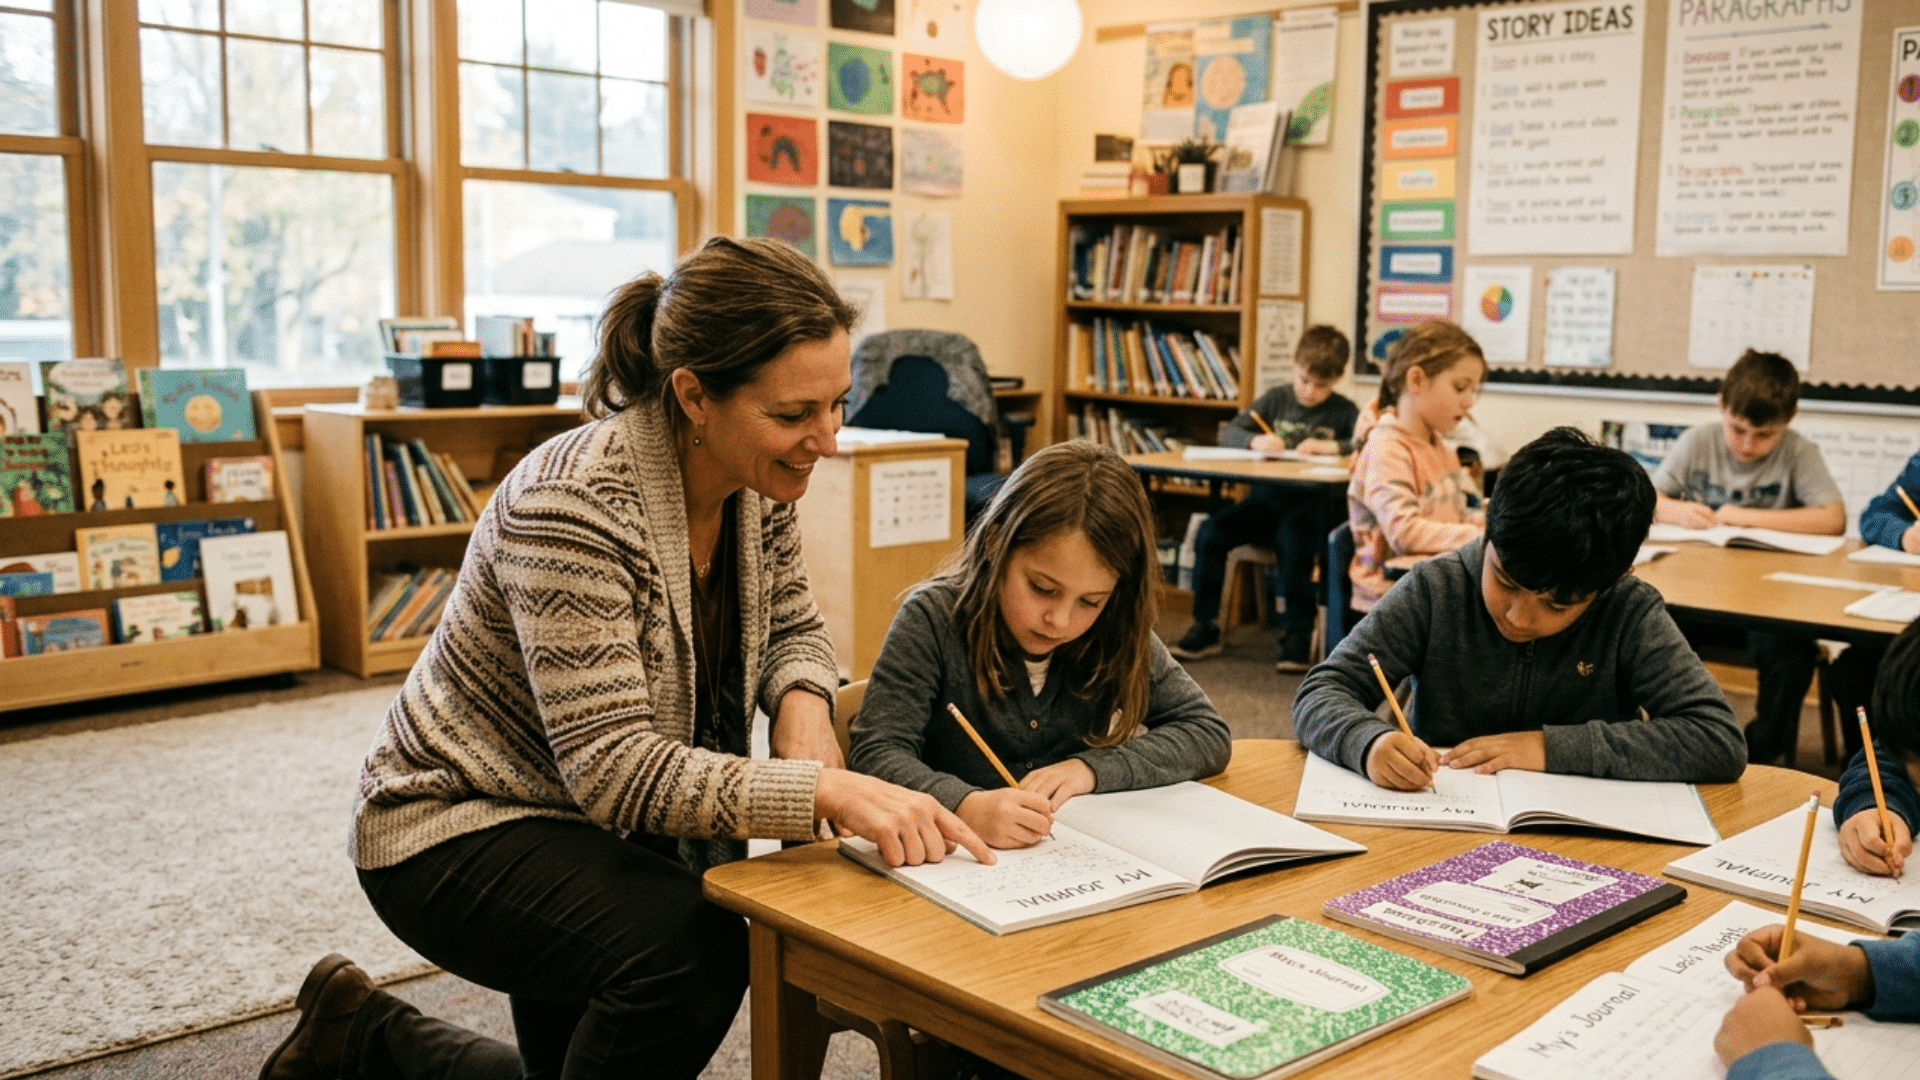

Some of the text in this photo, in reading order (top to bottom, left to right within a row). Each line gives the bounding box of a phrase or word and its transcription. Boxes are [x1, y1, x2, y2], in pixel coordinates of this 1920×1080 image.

[1487, 5, 1633, 40] STORY IDEAS
[1903, 39, 1920, 61] P
[1006, 869, 1152, 908] MY JOURNAL
[1826, 888, 1875, 904] MY
[1570, 982, 1640, 1028] Journal
